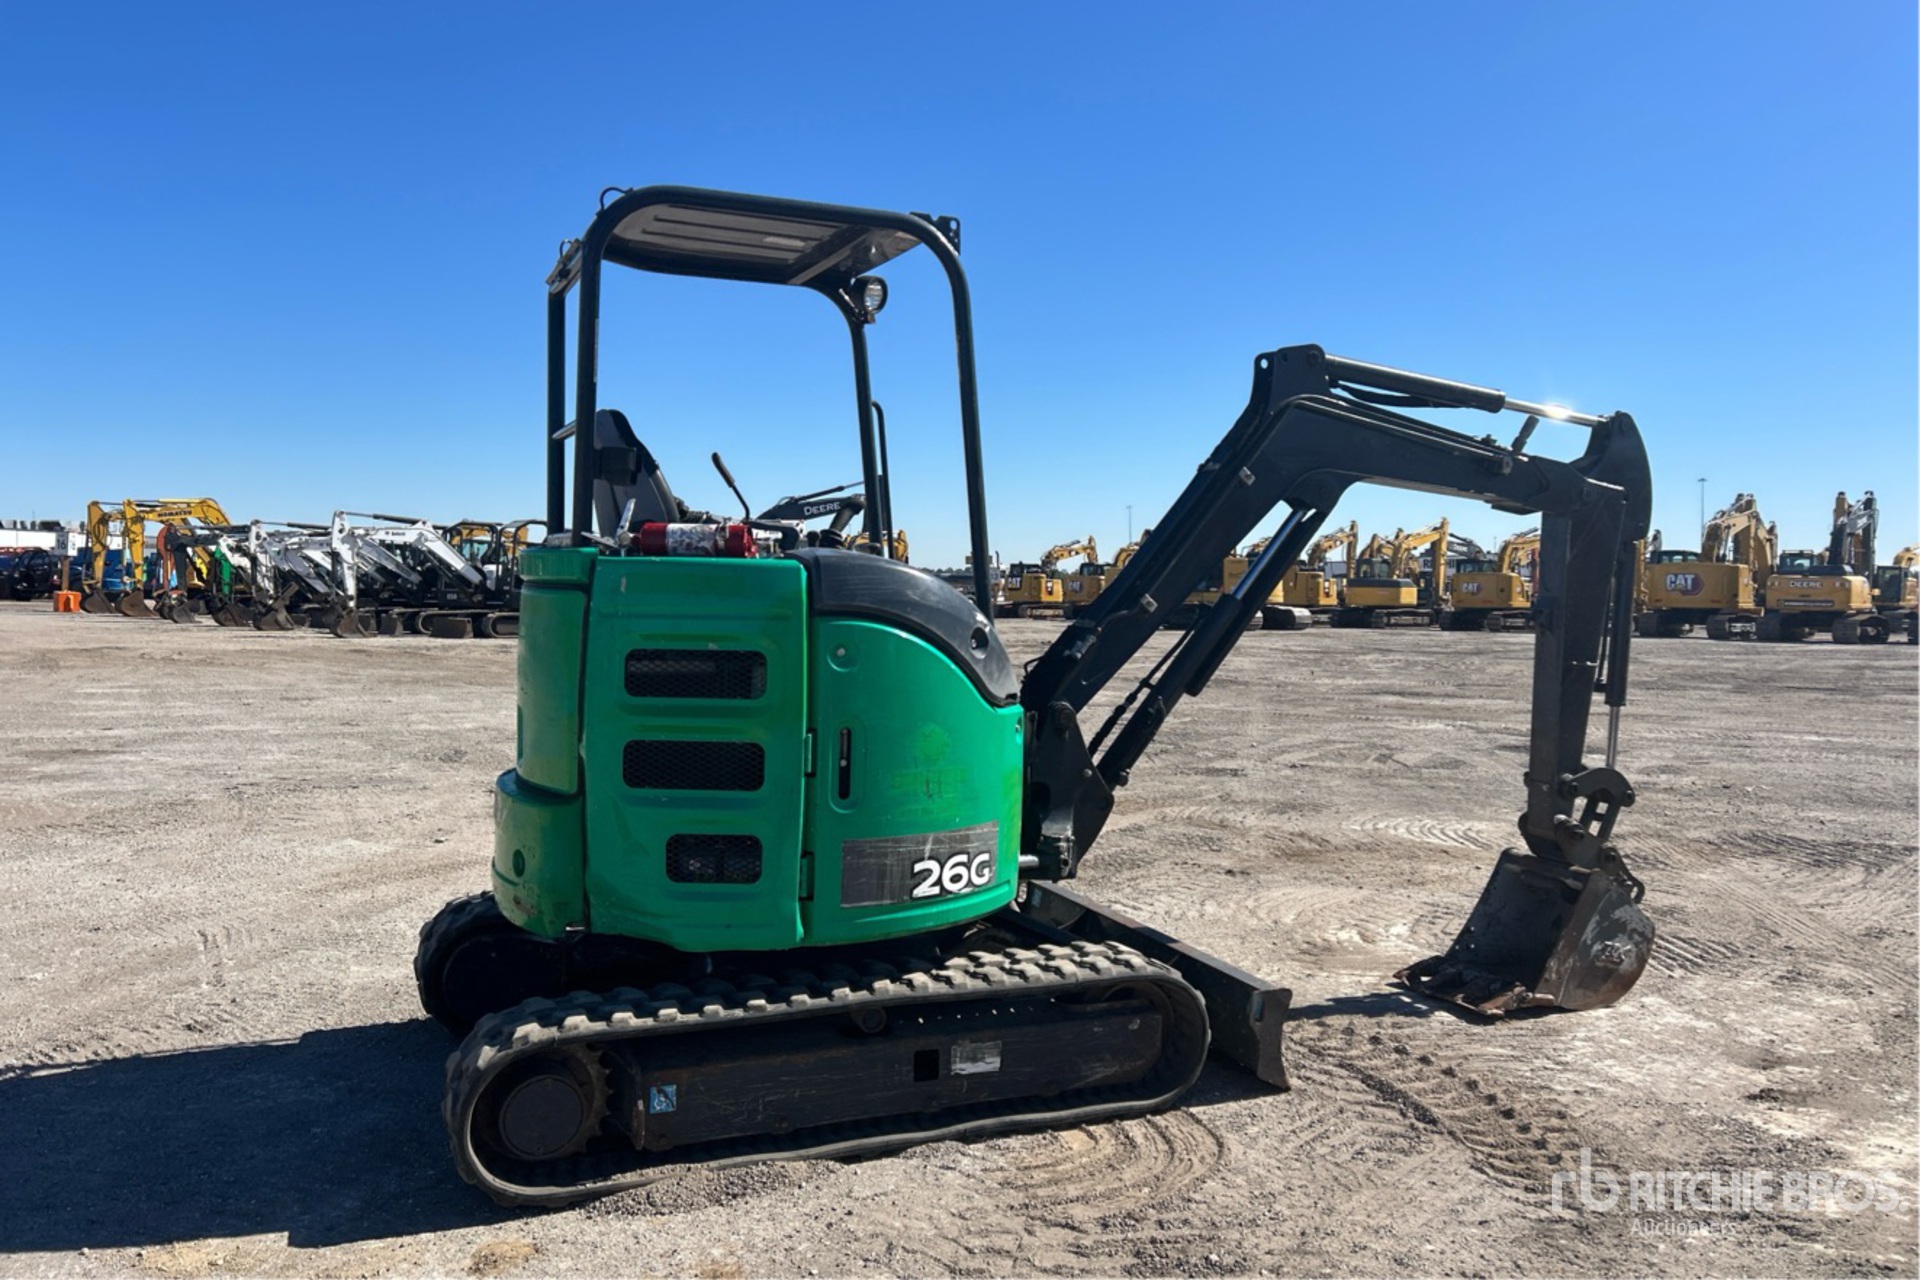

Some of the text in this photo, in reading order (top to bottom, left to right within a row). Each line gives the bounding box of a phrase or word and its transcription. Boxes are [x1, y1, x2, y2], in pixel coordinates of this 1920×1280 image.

[803, 501, 841, 515] DEERE
[1462, 582, 1478, 592] CAT
[1666, 574, 1695, 591] CAT
[912, 852, 991, 898] 26G
